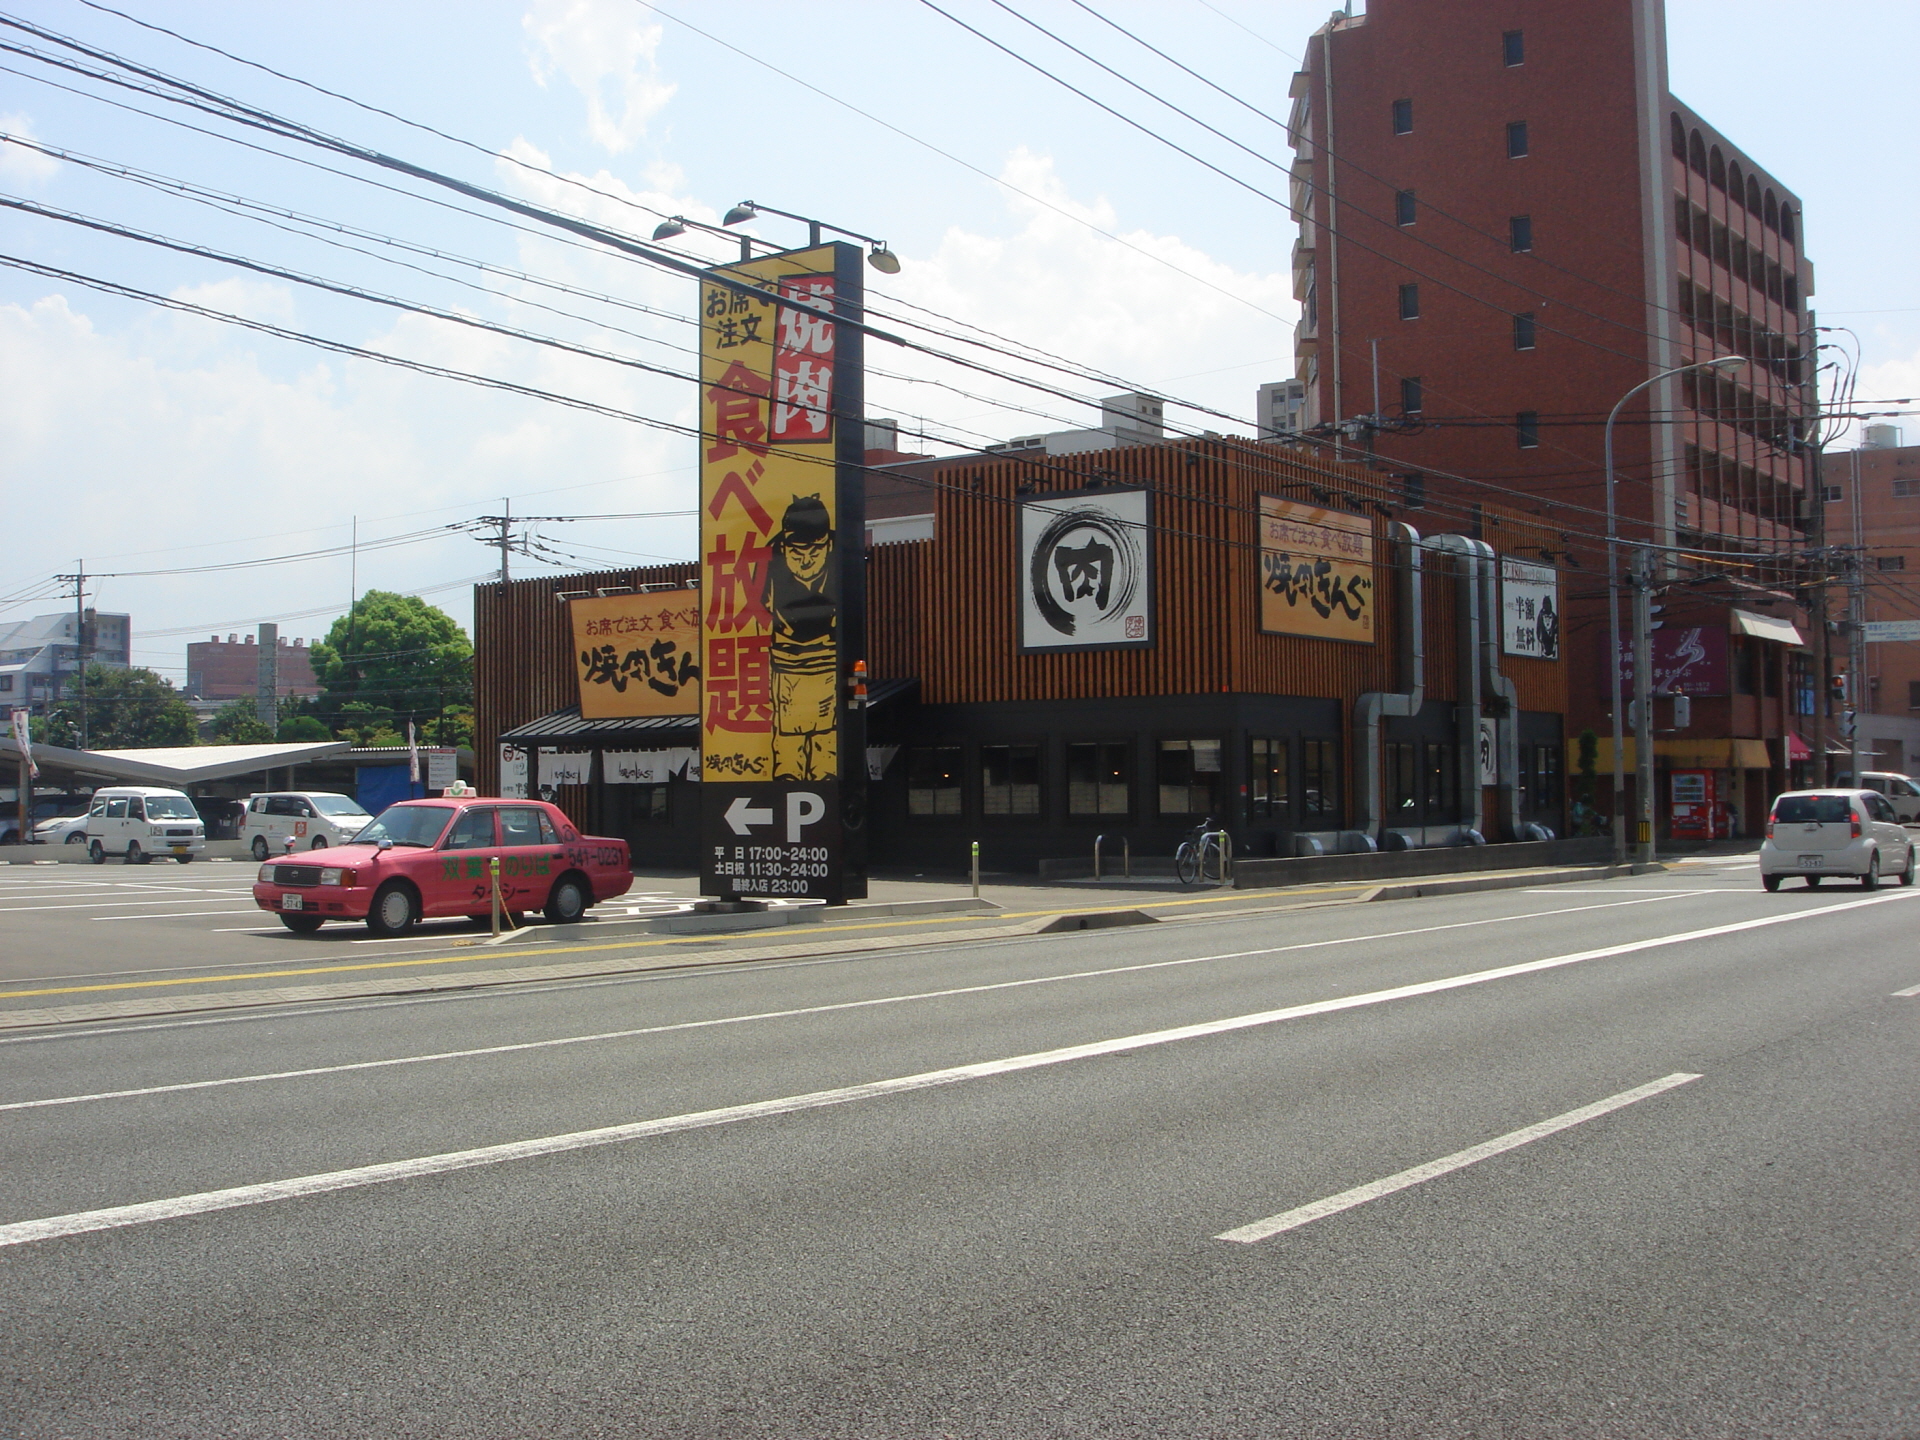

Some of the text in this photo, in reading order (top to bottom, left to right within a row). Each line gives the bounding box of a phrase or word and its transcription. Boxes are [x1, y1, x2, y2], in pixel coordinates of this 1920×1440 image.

[716, 313, 762, 349] 注文
[774, 283, 835, 434] 焼肉
[705, 359, 774, 736] 食べ放題
[1270, 522, 1364, 558] お席で注文 食べ放題
[1055, 535, 1114, 611] 肉
[1264, 551, 1372, 621] 焼肉きんぐ
[1515, 596, 1535, 621] 半額
[586, 614, 654, 637] お席で注文
[1516, 626, 1535, 652] 無料
[581, 638, 699, 697] 焼肉きん
[705, 751, 769, 776] 焼肉きんぐ
[787, 792, 825, 842] P
[442, 853, 551, 881] 双葉 のりば
[568, 847, 624, 867] 541-0231
[714, 862, 745, 875] 土日祝
[732, 879, 808, 893] 最終入店 23:00
